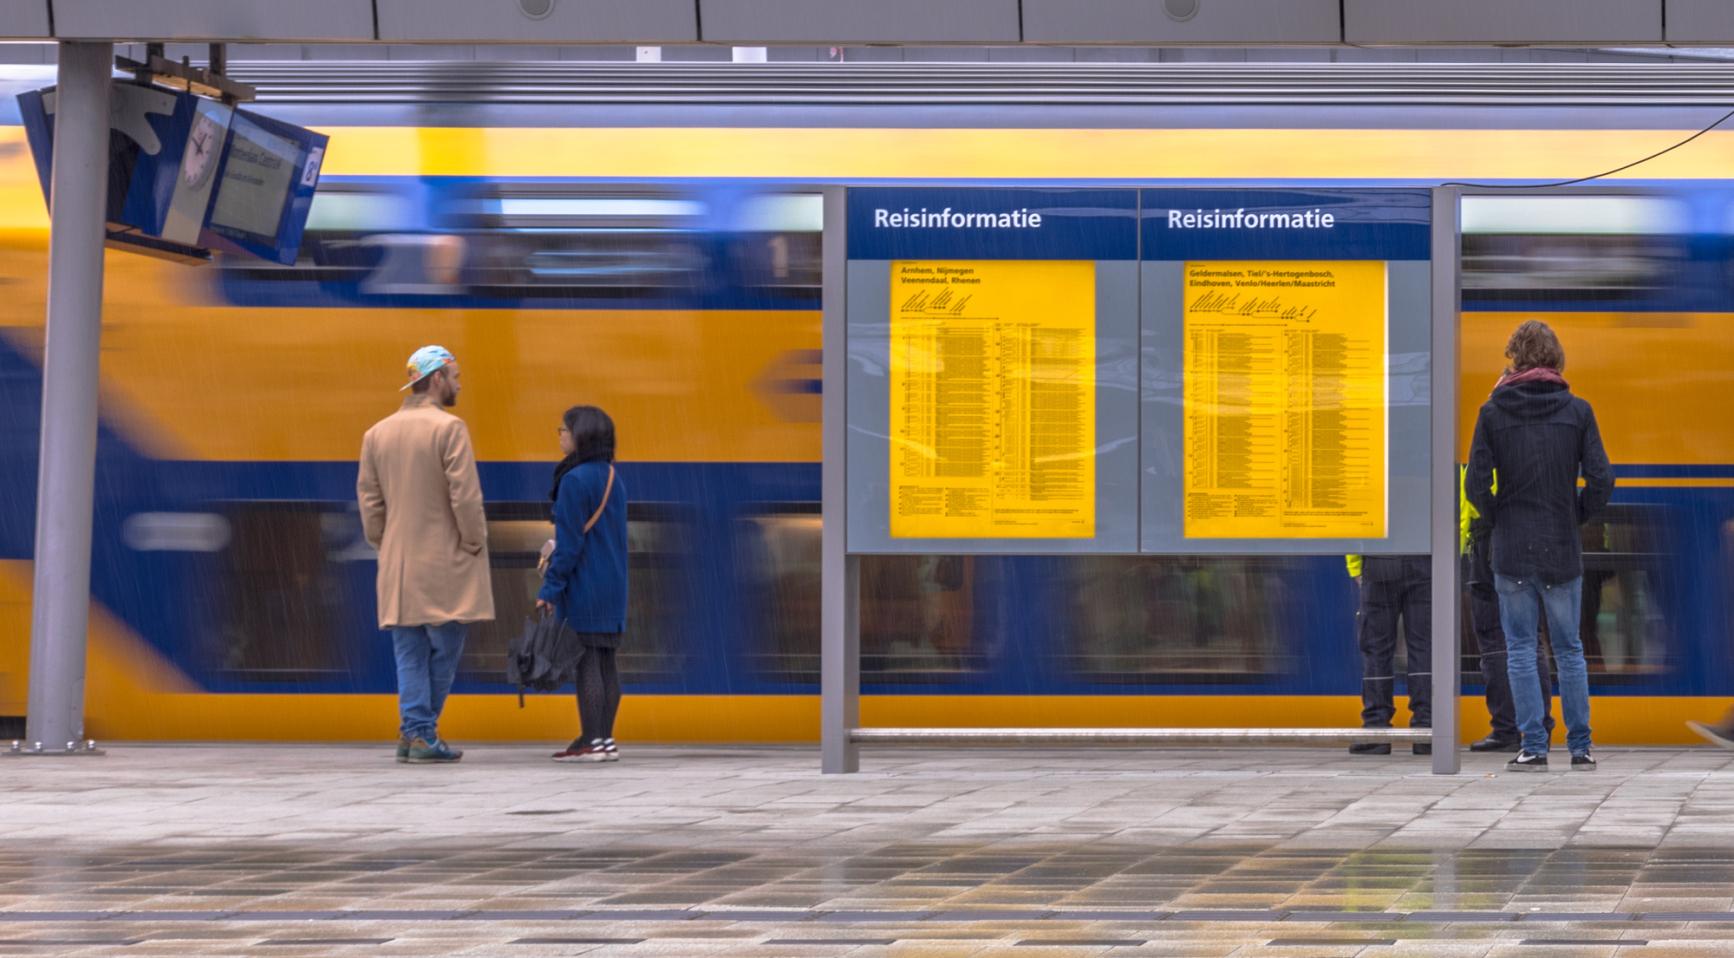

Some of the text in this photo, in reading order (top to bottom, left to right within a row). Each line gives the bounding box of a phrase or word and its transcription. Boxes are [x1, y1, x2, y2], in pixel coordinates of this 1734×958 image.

[874, 208, 1042, 228] Reisinformatie
[1168, 208, 1335, 229] Reisinformatie
[901, 267, 974, 276] Arnhem, Nijmegen
[1189, 270, 1245, 278] Geldermalsen,
[901, 277, 981, 285] Veenendaal, Rhenen
[1189, 280, 1336, 288] Eindhoven, Venlo/Heerlen/Maastricht
